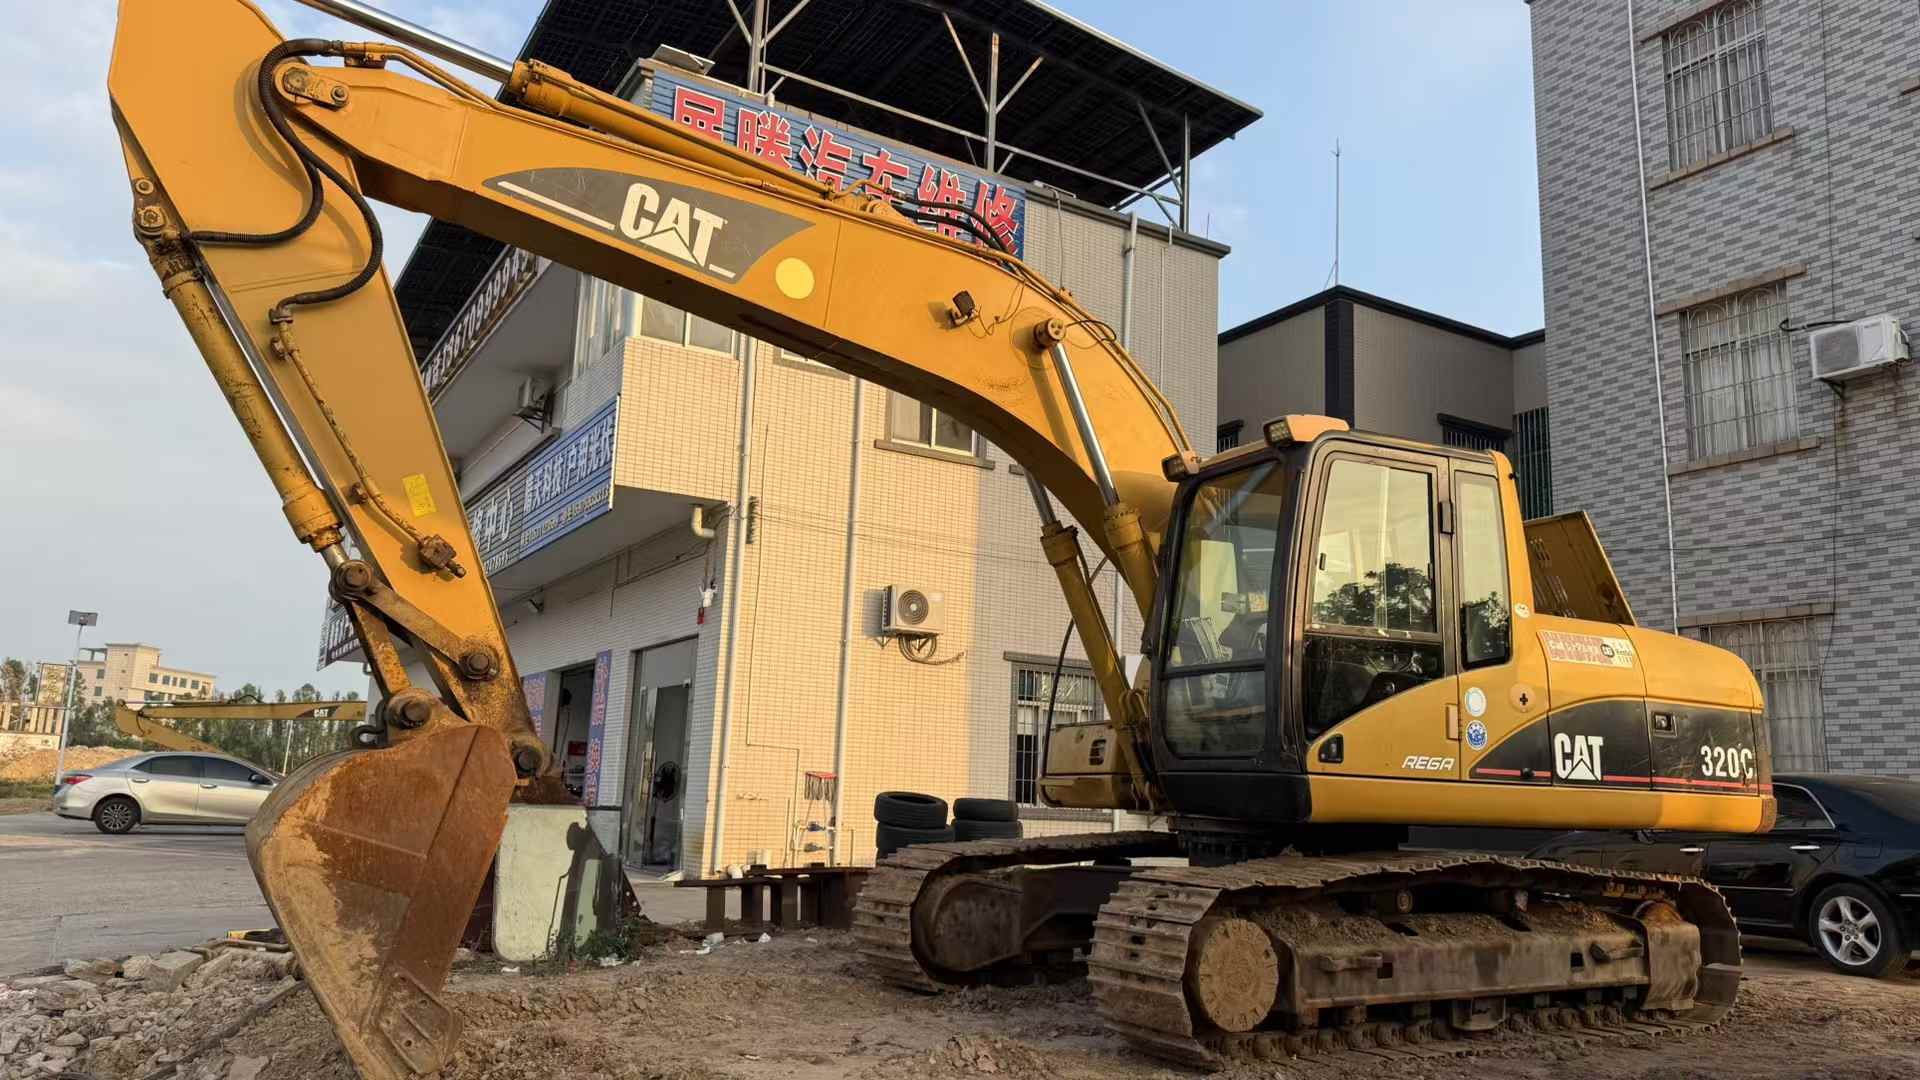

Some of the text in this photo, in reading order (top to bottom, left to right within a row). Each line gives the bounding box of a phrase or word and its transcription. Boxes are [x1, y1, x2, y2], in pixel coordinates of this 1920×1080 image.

[619, 182, 726, 267] CAT
[314, 708, 329, 718] CAT
[1401, 755, 1455, 771] REGA
[1554, 732, 1604, 782] CAT
[1700, 744, 1754, 779] 320C
